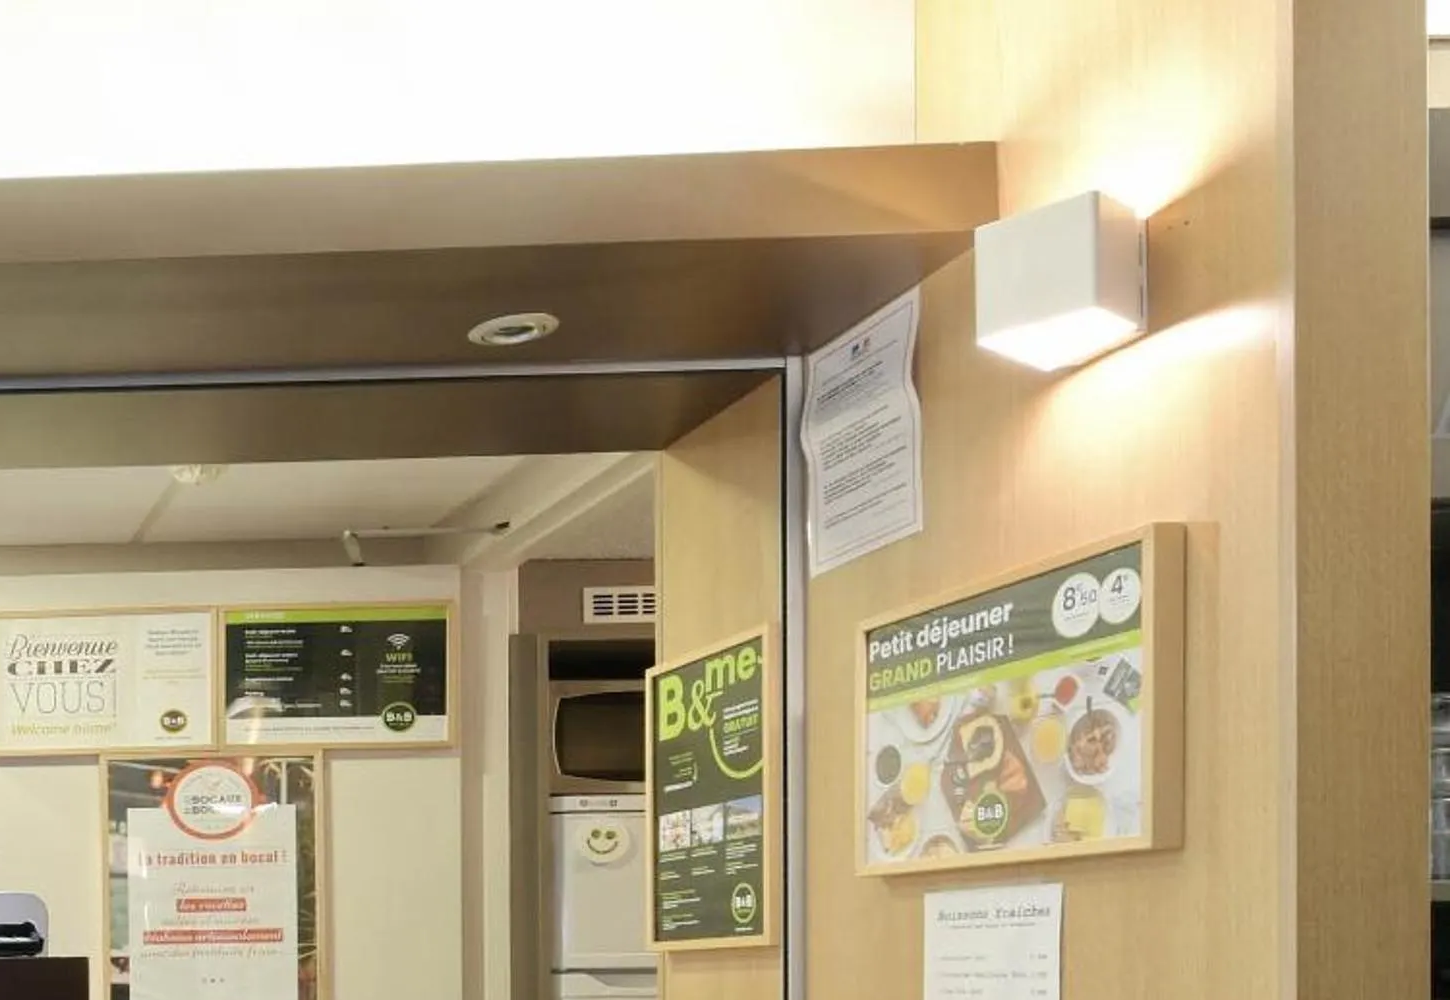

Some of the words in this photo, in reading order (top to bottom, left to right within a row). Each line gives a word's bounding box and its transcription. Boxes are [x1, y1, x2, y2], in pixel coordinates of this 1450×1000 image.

[869, 630, 913, 663] Petit
[916, 602, 1014, 648] déjeuner
[10, 633, 118, 660] Bienvenue
[386, 652, 413, 662] WIFI
[8, 658, 117, 675] CHEZ
[870, 657, 932, 692] GRAND
[937, 637, 1004, 675] PLAISIR
[157, 851, 217, 865] tradition
[221, 854, 237, 864] en
[241, 850, 279, 864] bocal
